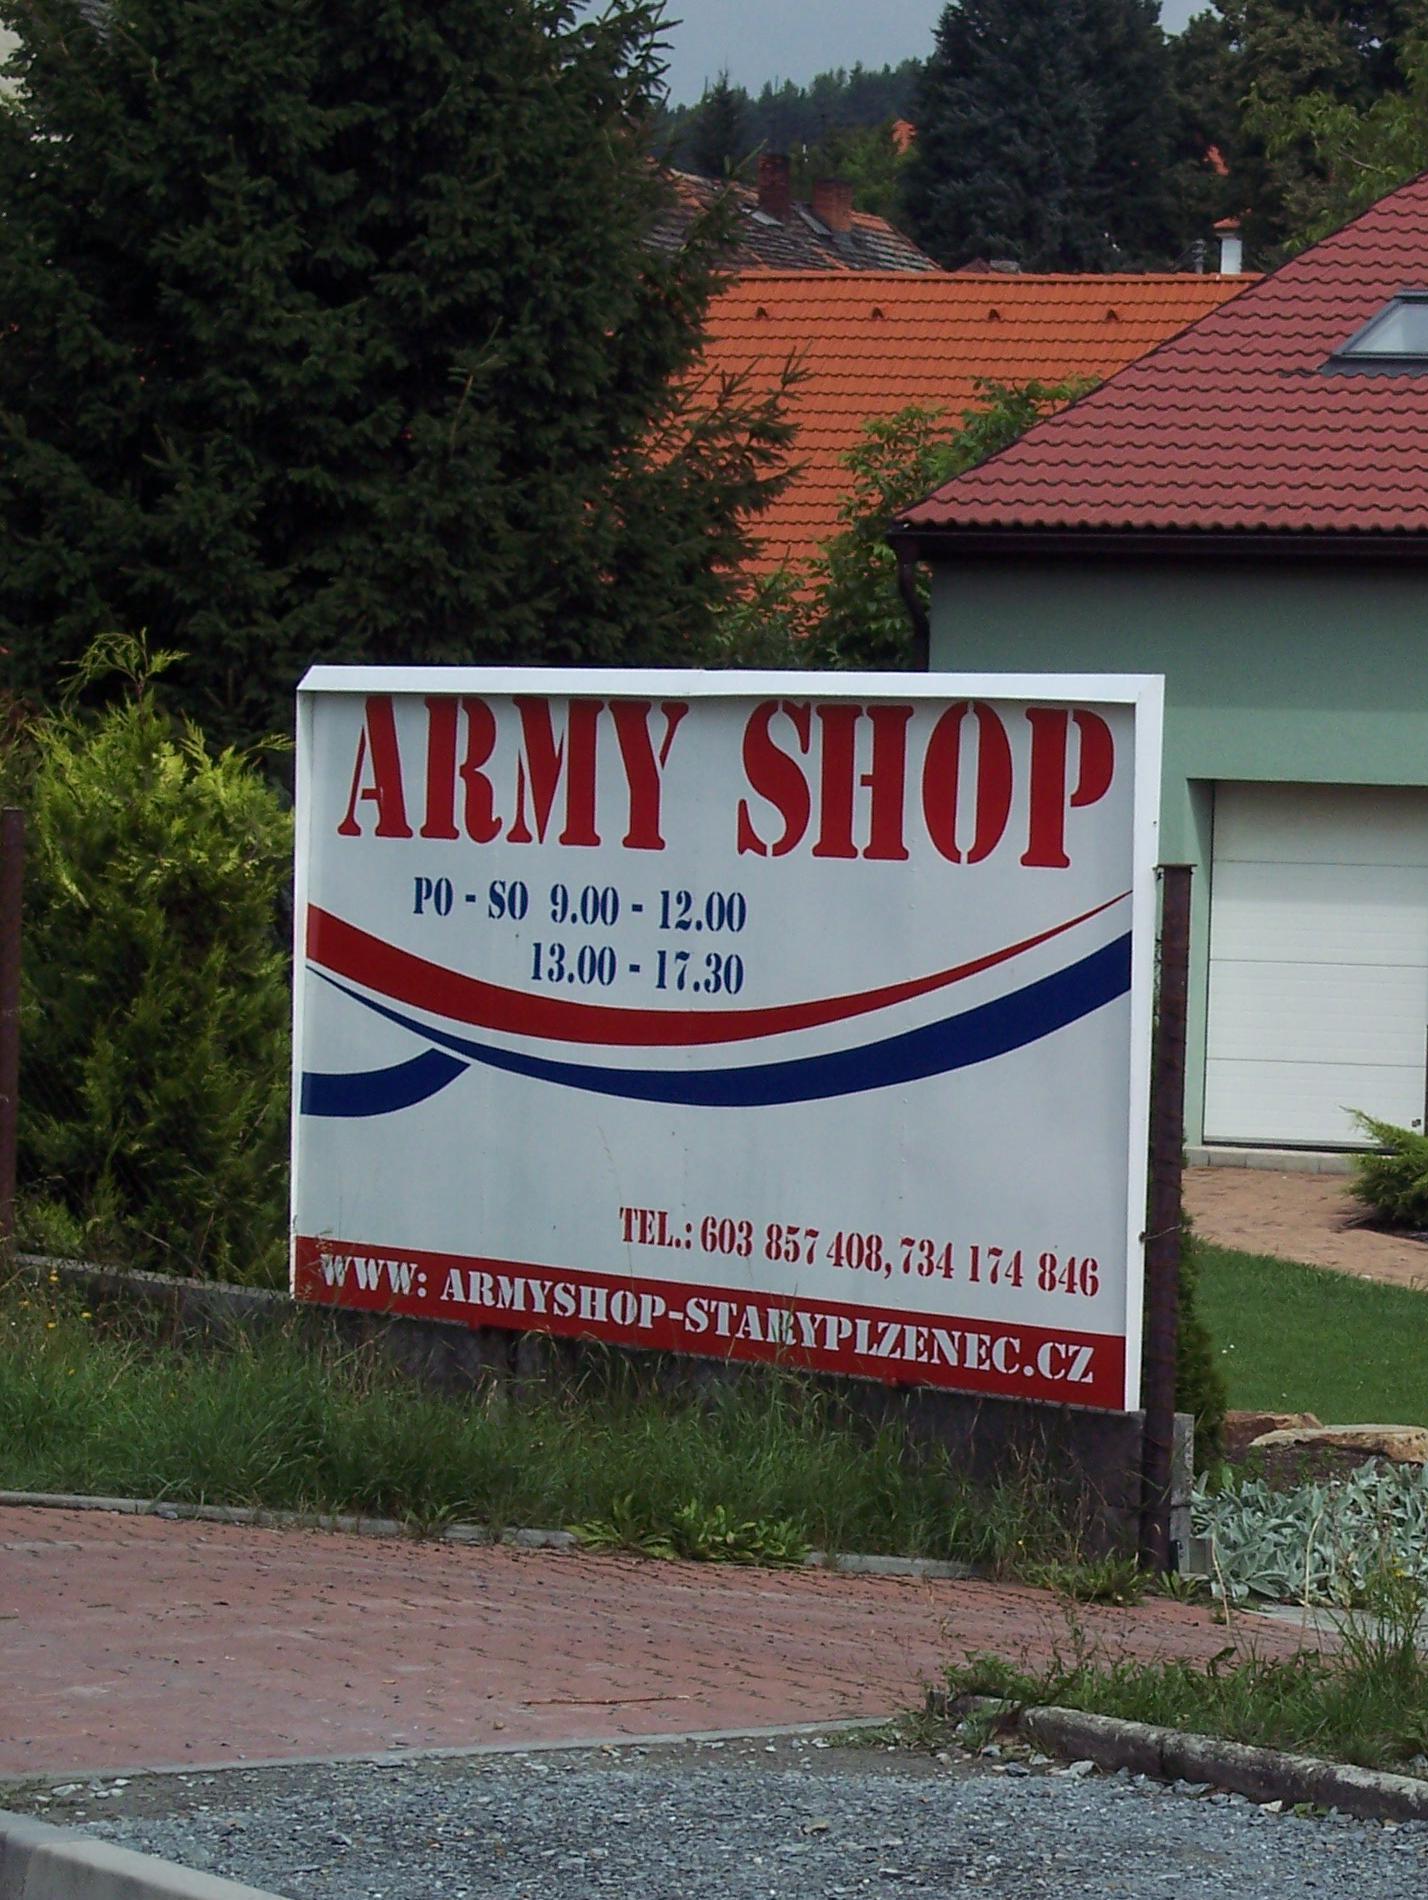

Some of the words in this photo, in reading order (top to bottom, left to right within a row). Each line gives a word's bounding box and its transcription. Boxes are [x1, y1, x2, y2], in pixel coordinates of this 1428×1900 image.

[337, 695, 689, 850] ARMY
[737, 700, 1115, 868] SHOP
[412, 876, 453, 917] PO
[487, 879, 529, 920] SO
[549, 883, 620, 926] 9.00
[658, 889, 747, 933] 12.00
[531, 942, 617, 986] 13.00
[655, 949, 745, 995] 17.30
[619, 1206, 692, 1250] TEL.:
[700, 1215, 753, 1258] 603
[764, 1223, 820, 1266] 857
[968, 1245, 1024, 1288] 174
[1037, 1252, 1100, 1298] 846
[320, 1253, 428, 1299] WWW:
[439, 1267, 1095, 1384] ARMYSHOP-STARYPLZENEC.CZ
